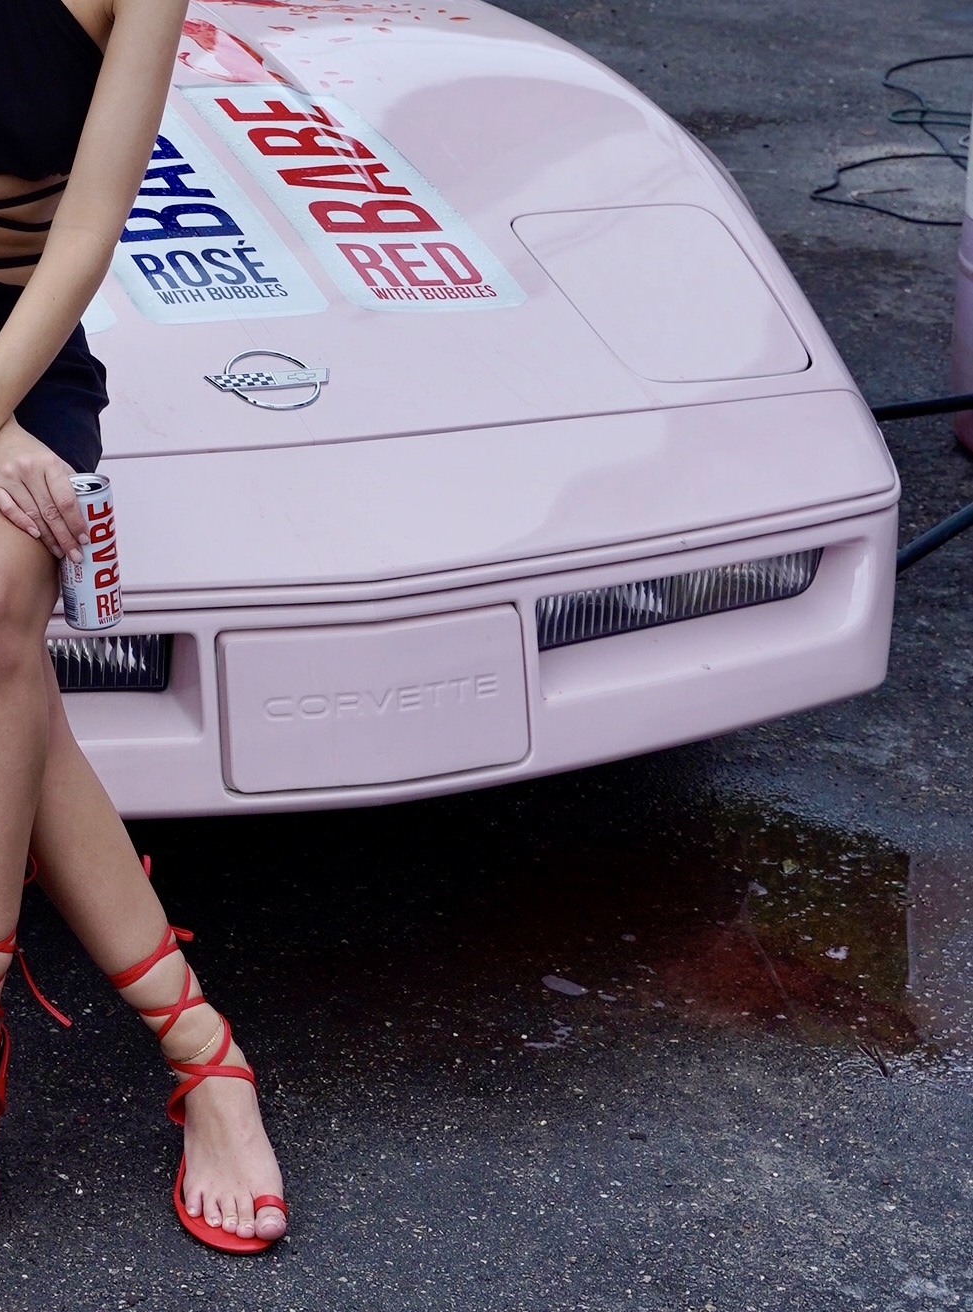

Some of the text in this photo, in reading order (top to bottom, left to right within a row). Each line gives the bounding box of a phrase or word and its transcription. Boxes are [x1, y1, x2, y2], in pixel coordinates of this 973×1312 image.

[214, 97, 443, 234] BABE
[130, 240, 279, 291] ROSÉ
[336, 242, 482, 287] RED
[157, 283, 288, 305] WITH BUBBLES
[370, 284, 497, 302] WITH BUBBLES
[264, 672, 499, 722] CORVETTE
